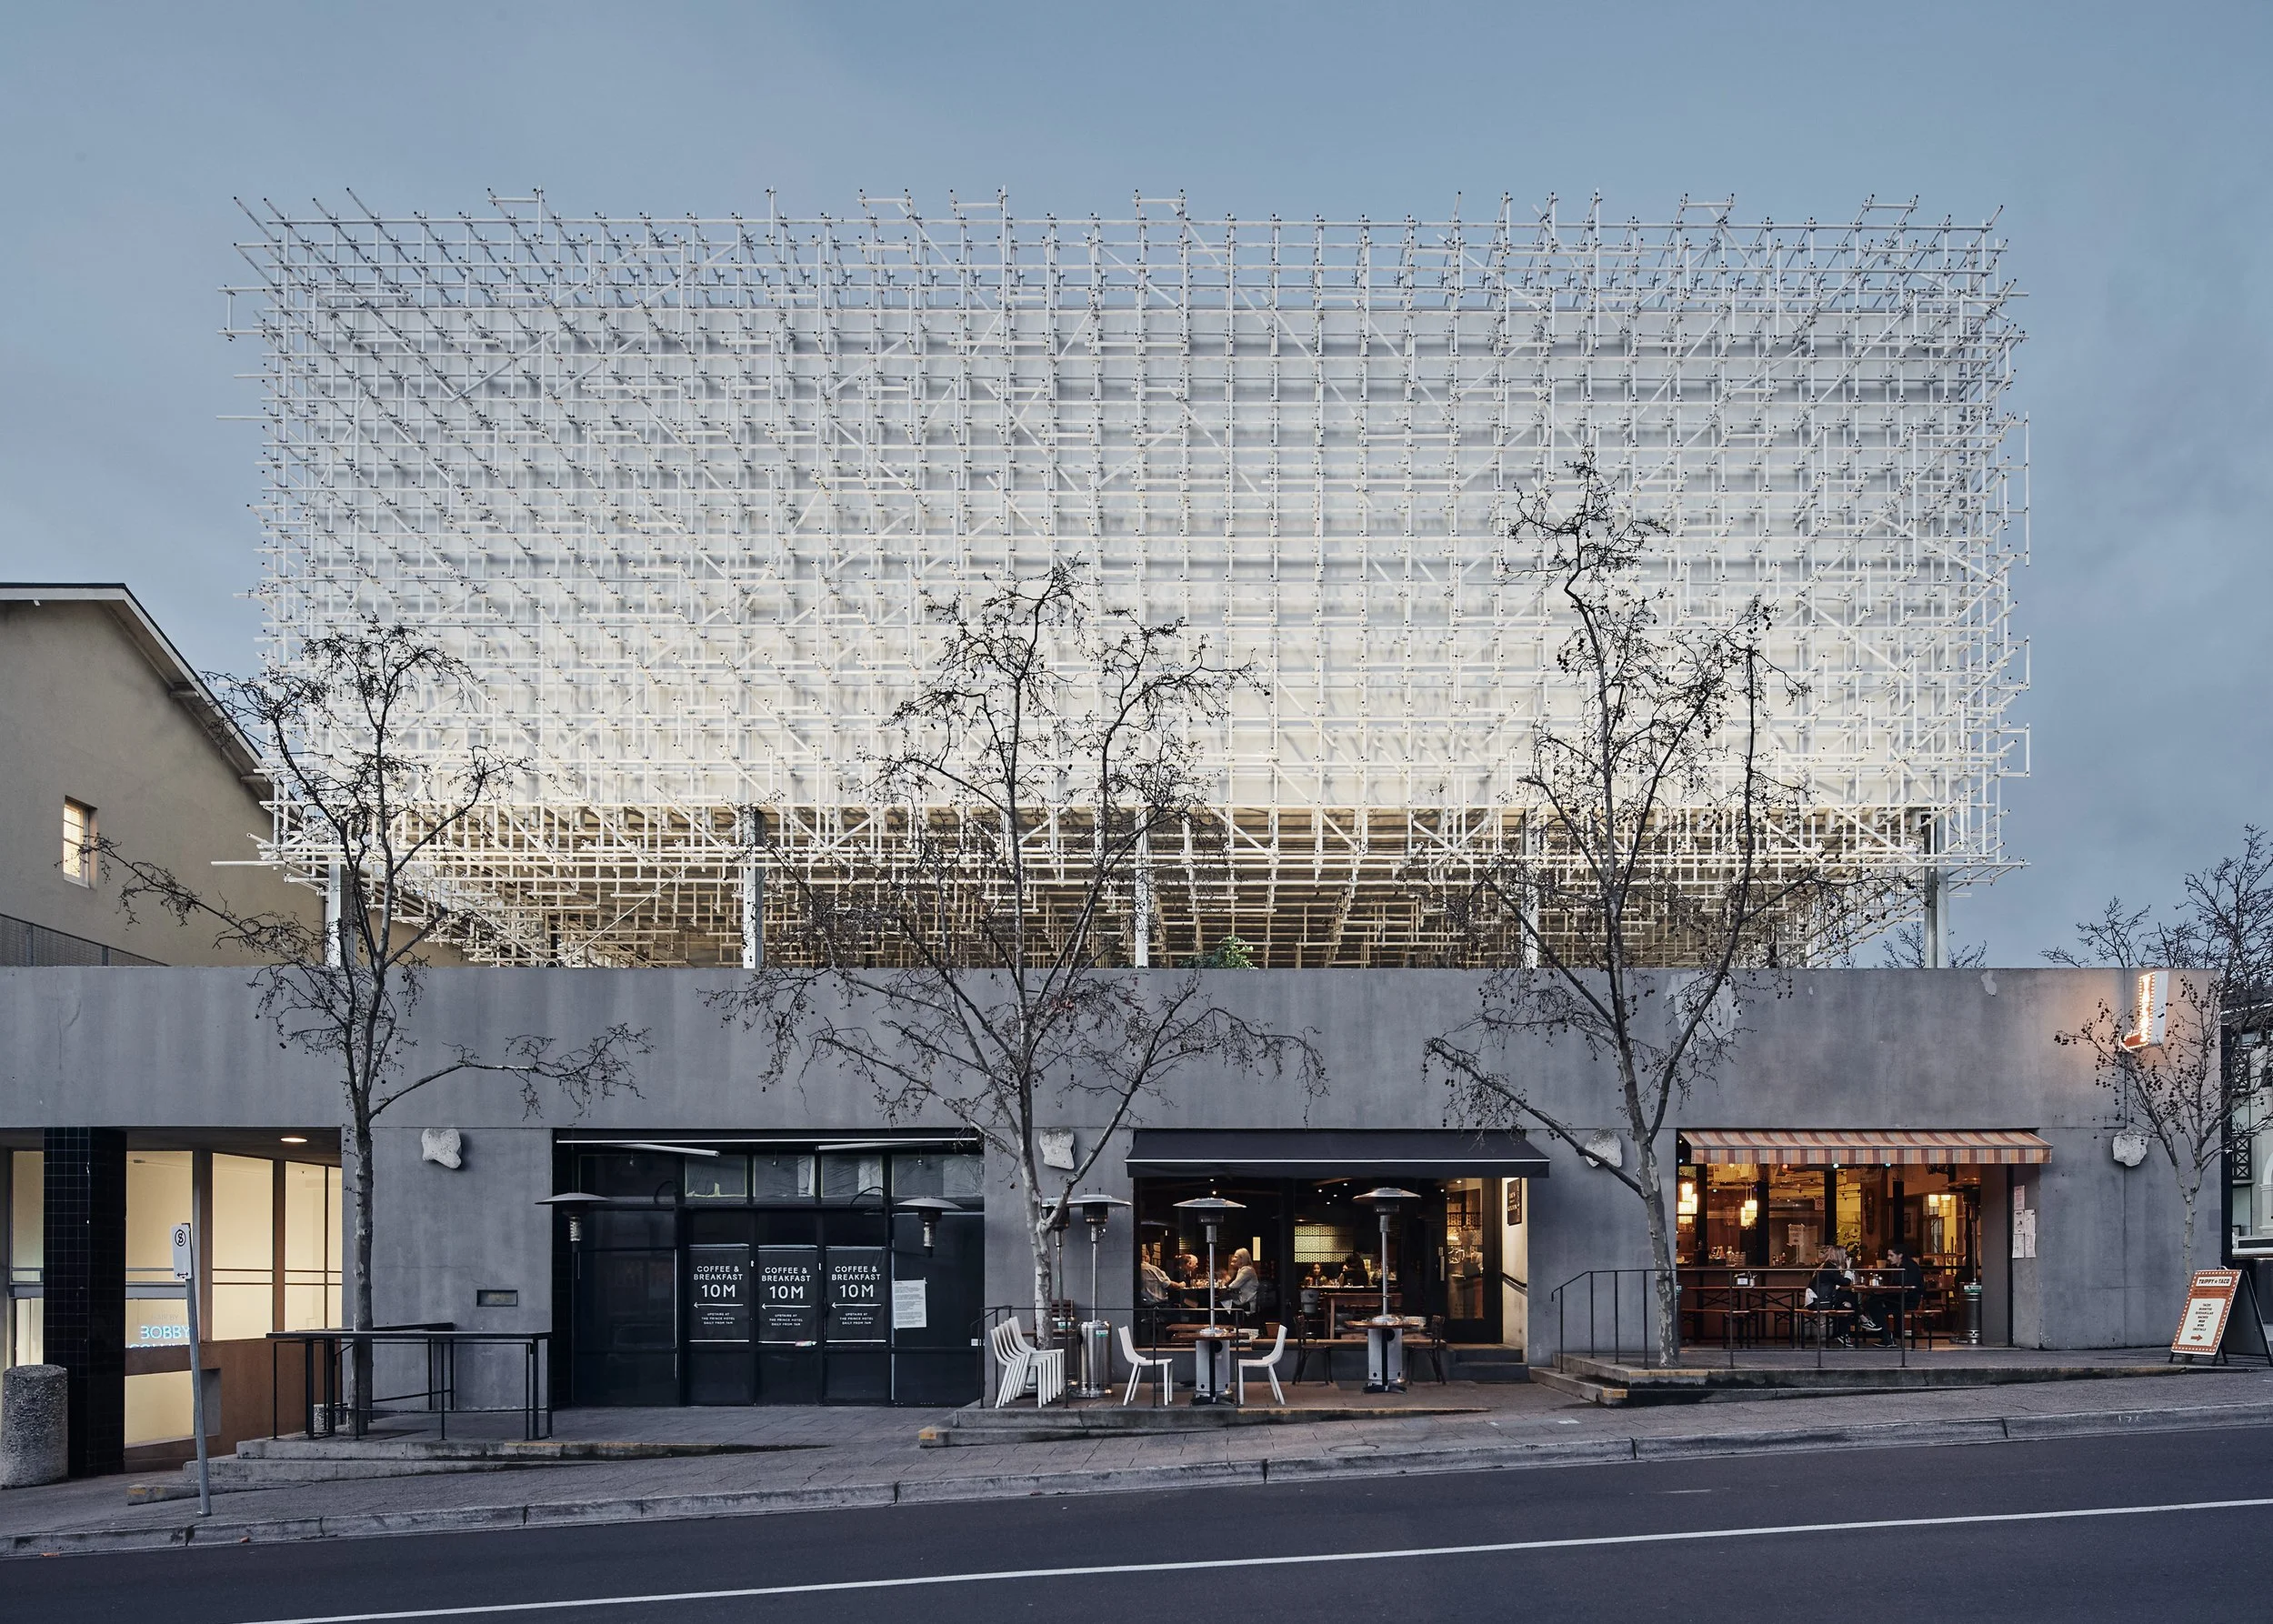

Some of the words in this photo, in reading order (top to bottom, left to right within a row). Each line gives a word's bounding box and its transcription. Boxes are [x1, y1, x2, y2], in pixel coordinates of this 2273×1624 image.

[701, 1284, 736, 1298] 10M
[769, 1286, 804, 1299] 10M
[839, 1284, 874, 1298] 10M
